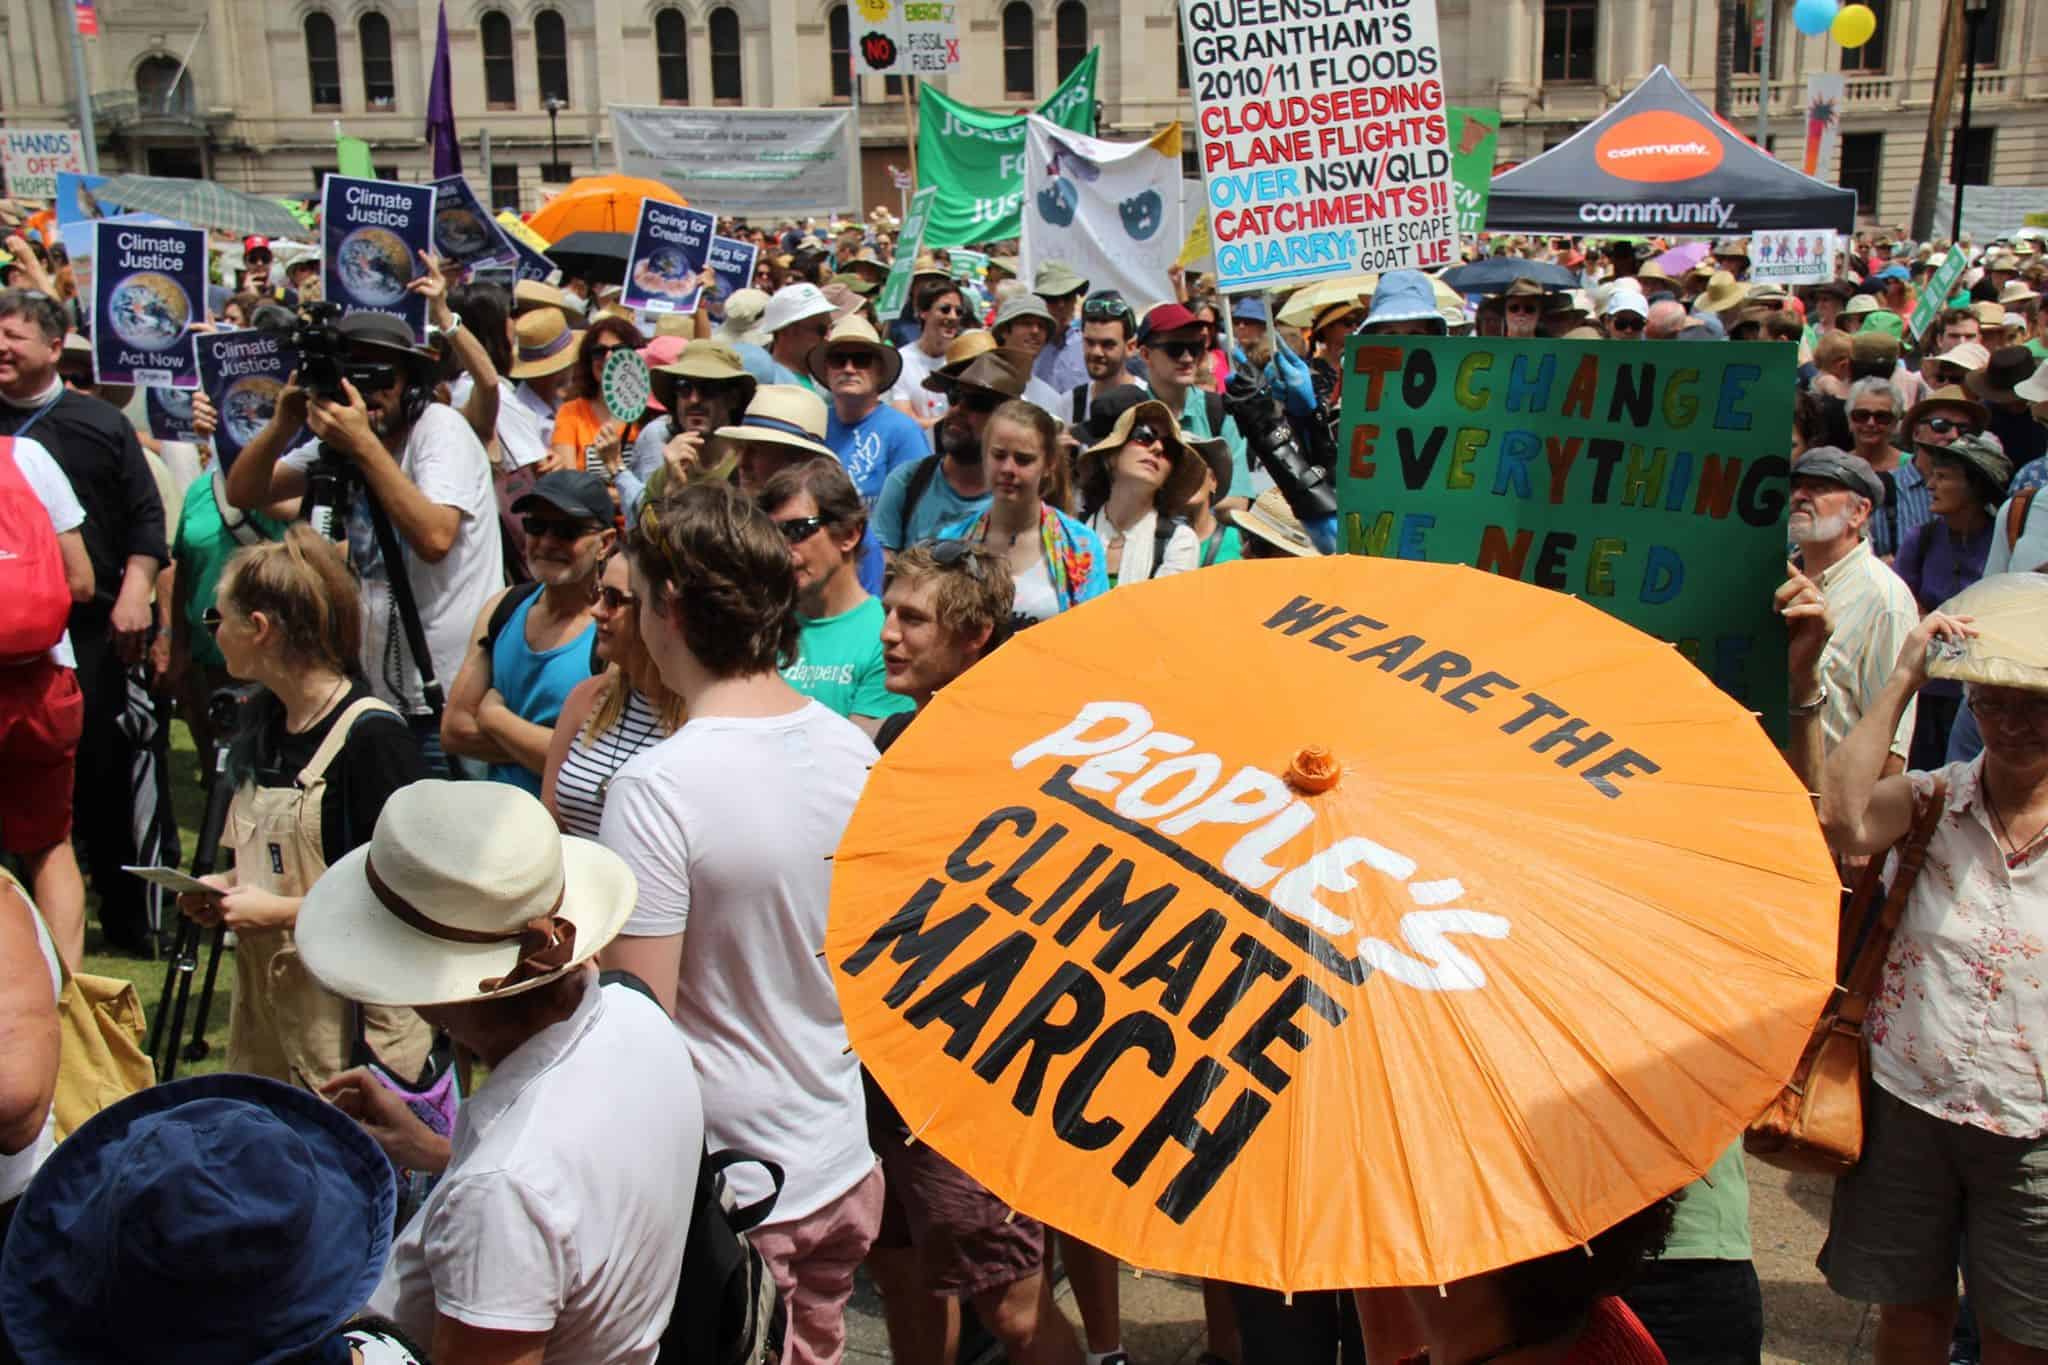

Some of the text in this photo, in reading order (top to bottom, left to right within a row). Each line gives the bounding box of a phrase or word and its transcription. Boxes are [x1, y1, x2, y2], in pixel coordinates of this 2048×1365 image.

[866, 37, 891, 61] NO
[1193, 13, 1412, 65] GRANTHAM'S
[1198, 47, 1438, 101] 2010/11 FLOODS
[9, 134, 71, 153] HANDS
[1205, 115, 1447, 173] PLANE FLIGHTS
[27, 157, 59, 174] OFF
[1209, 149, 1449, 208] OVER NSW/QLD
[12, 176, 56, 194] HOPE
[345, 187, 412, 210] Climate
[346, 207, 409, 228] Justice
[648, 210, 707, 233] Caring for
[1214, 182, 1449, 242] CATCHMENTS!!
[117, 232, 186, 254] Climate
[650, 226, 700, 247] Creation
[1357, 224, 1395, 249] THE
[1399, 216, 1452, 246] SCAPE
[119, 252, 184, 270] Justice
[732, 249, 748, 262] for
[1360, 240, 1451, 272] GOAT LIE
[118, 351, 184, 368] Act Now
[212, 339, 279, 359] Climate
[218, 357, 281, 377] Justice
[1353, 345, 1761, 432] TO CHANGE
[1349, 424, 1790, 527] EVERYTHING
[1345, 511, 1685, 605] WE NEED
[1499, 692, 1661, 799] THE
[1012, 700, 1511, 992] PEOPLE'S
[944, 806, 1348, 1096] CLIMATE
[840, 878, 1272, 1225] MARCH
